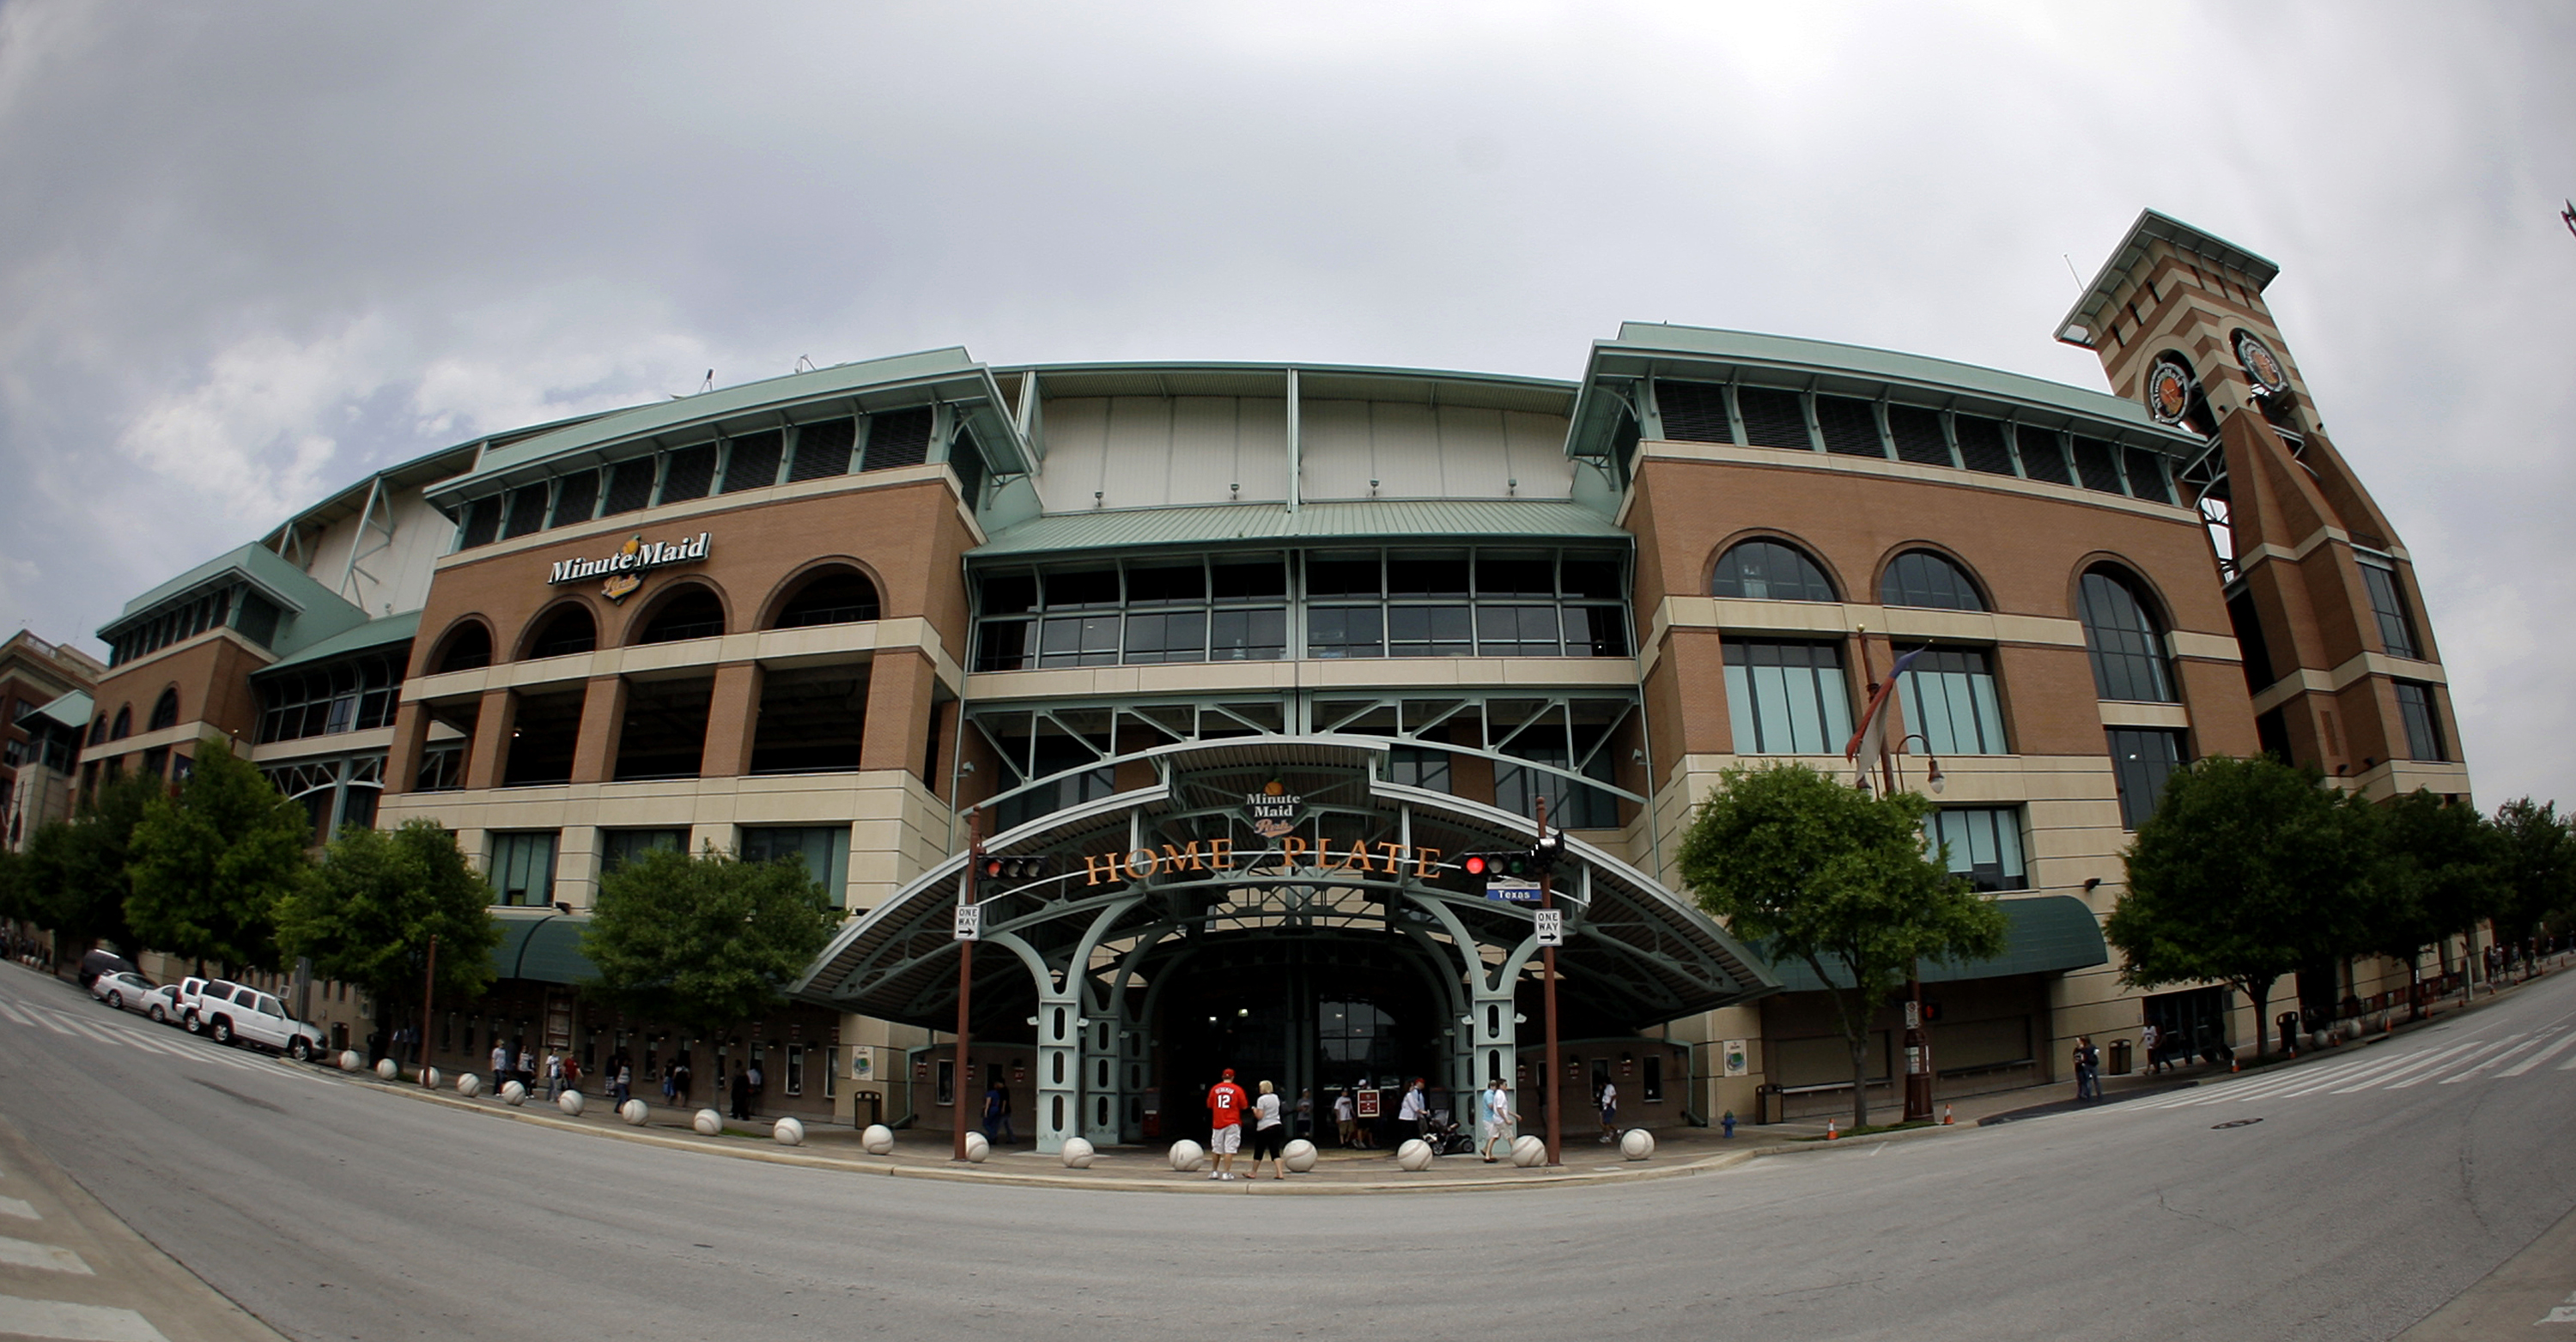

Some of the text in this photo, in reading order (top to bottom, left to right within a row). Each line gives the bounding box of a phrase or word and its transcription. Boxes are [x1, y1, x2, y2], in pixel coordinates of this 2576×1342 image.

[547, 532, 711, 584] Minute Maid
[1246, 792, 1301, 805] Minute
[1254, 805, 1294, 817] Maid
[1084, 835, 1441, 886] HOME PLATE
[1498, 890, 1530, 899] Texas
[958, 908, 977, 917] ONE
[1538, 913, 1558, 921] ONE
[1538, 922, 1558, 931] WAY
[1218, 1095, 1230, 1108] 12
